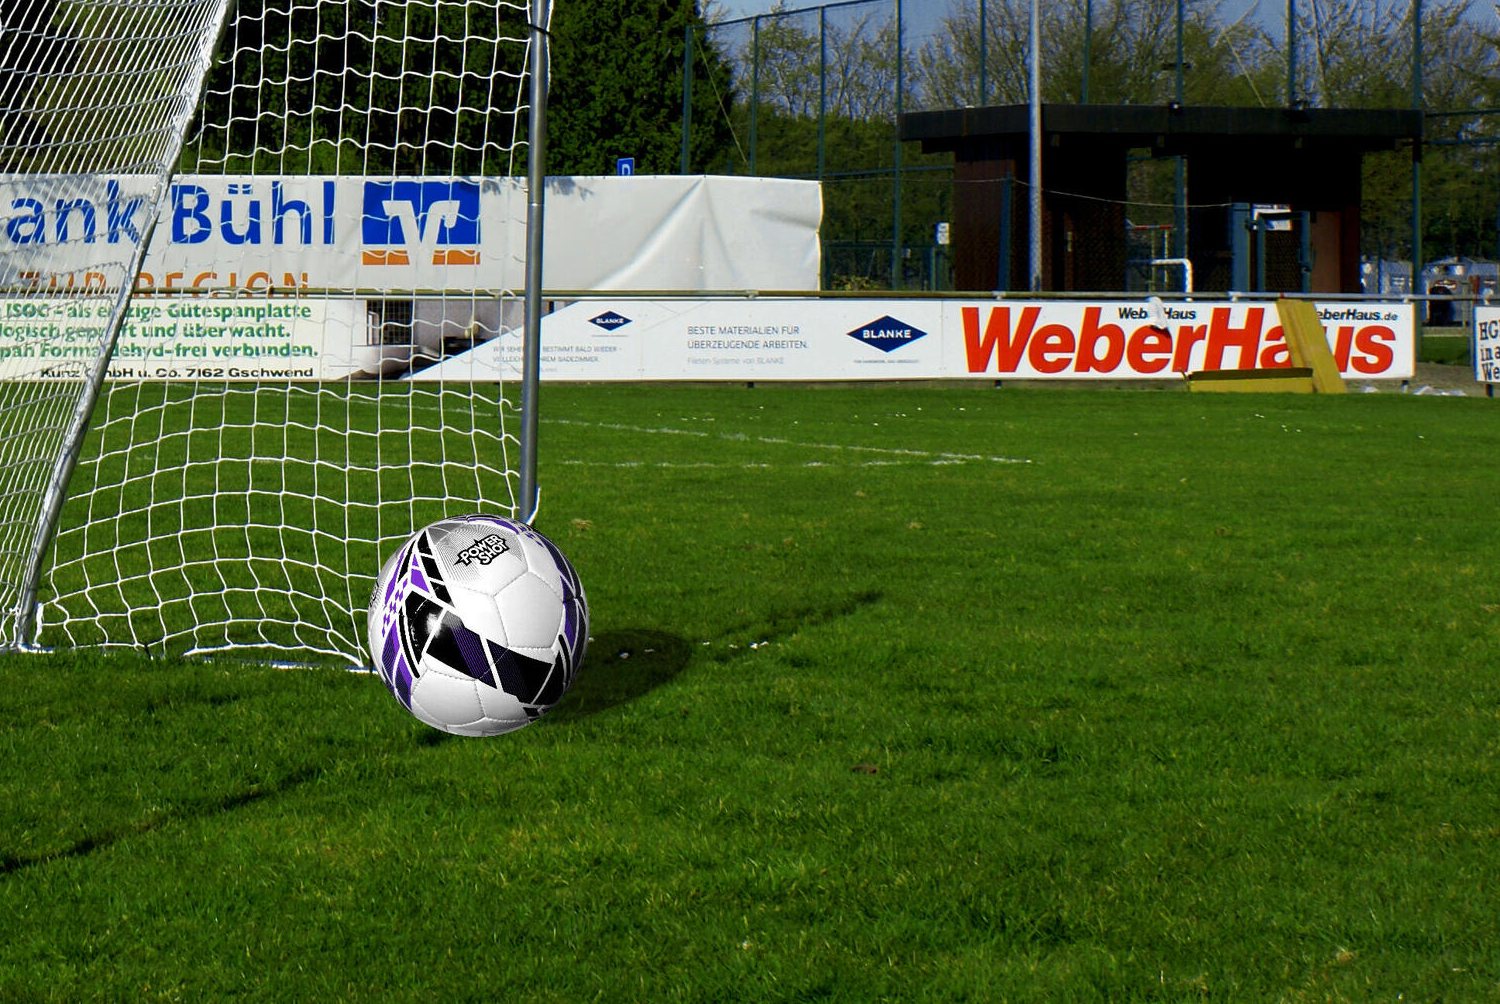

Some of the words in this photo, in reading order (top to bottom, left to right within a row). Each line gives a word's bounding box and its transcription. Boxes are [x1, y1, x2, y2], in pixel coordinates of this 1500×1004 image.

[171, 180, 336, 245] Bühl
[67, 303, 92, 318] als
[97, 303, 162, 323] eizige
[167, 303, 312, 323] Gütespanplatte
[1117, 307, 1197, 320] WebHaus
[1315, 308, 1398, 321] eberHaus.de
[65, 324, 137, 342] geprft
[141, 323, 178, 338] und
[182, 323, 292, 339] überwacht.
[687, 325, 716, 336] BESTE
[718, 325, 779, 336] MATERIALIEN
[862, 329, 912, 339] BLANKE
[40, 342, 208, 359] Formadehyd-frei
[211, 343, 319, 358] verbunden.
[228, 367, 315, 379] Gschwend
[459, 535, 502, 564] POWER
[478, 542, 508, 564] SHOT
